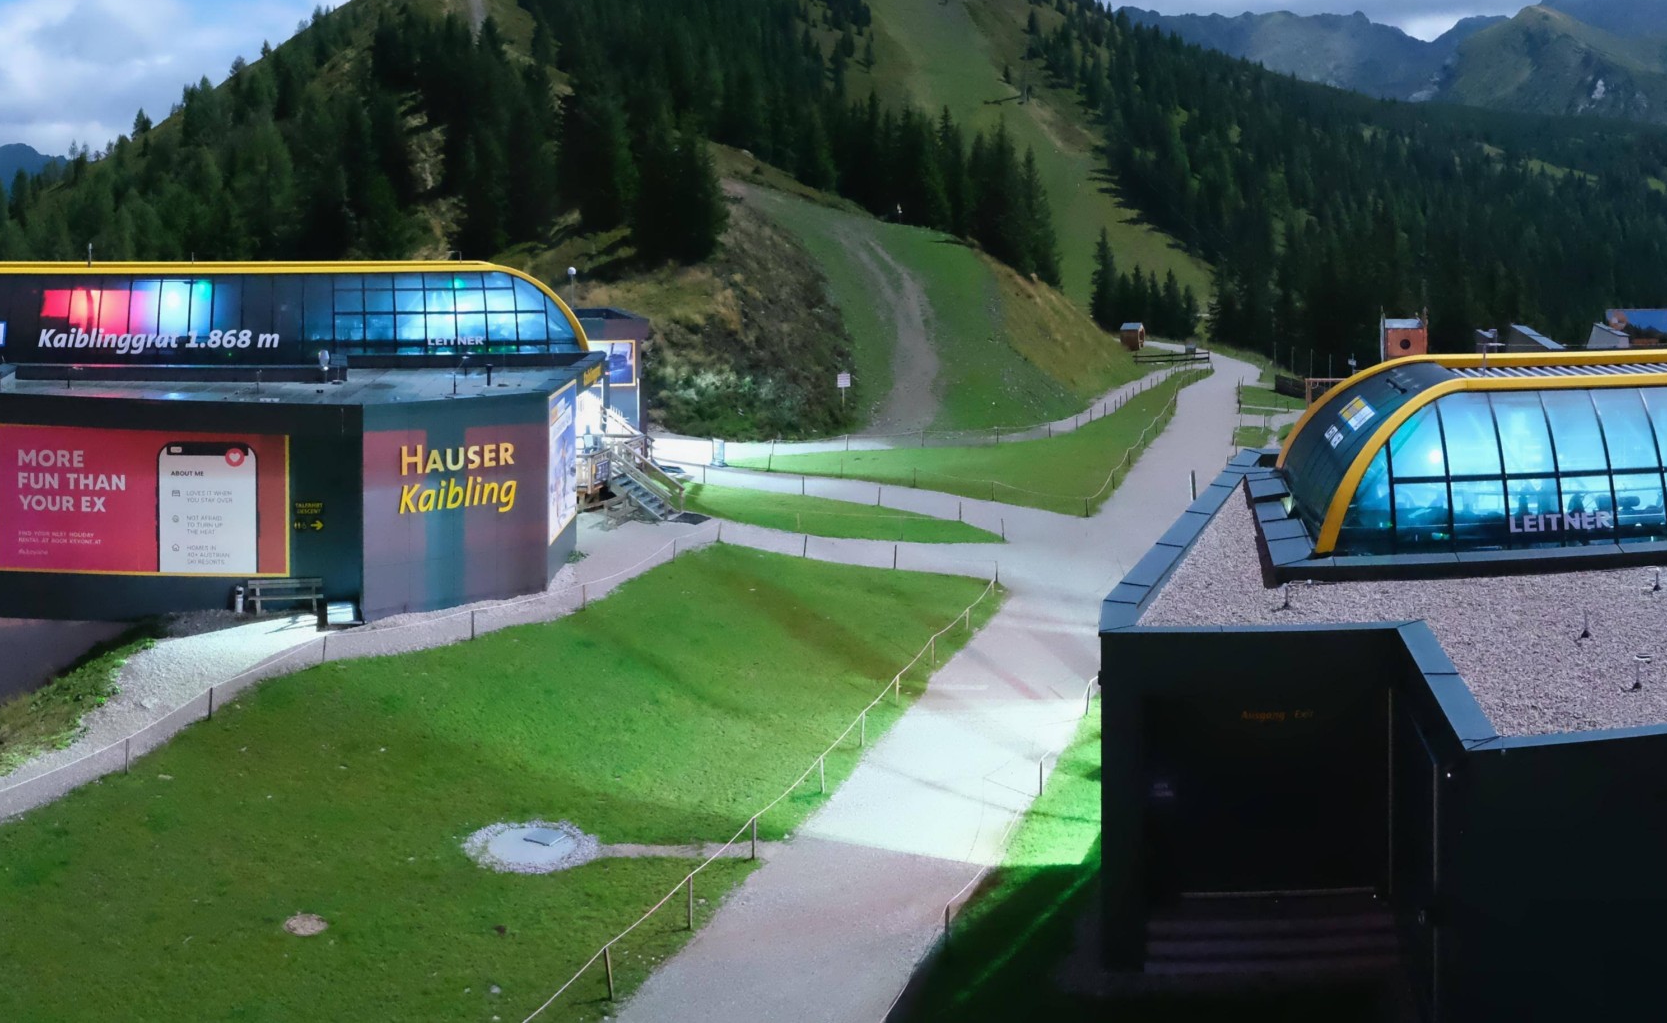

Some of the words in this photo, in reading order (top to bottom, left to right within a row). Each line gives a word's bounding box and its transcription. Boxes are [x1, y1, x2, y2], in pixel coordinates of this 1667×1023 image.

[38, 327, 178, 355] Kaiblinggrat
[185, 329, 252, 348] 1.868
[257, 334, 279, 348] m
[427, 336, 484, 346] LEITNER
[18, 449, 84, 467] MORE
[400, 442, 515, 475] HAUSER
[18, 472, 59, 489] FUN
[66, 473, 126, 491] THAN
[19, 495, 75, 512] YOUR
[81, 496, 107, 513] EX
[399, 476, 517, 514] Kaibling
